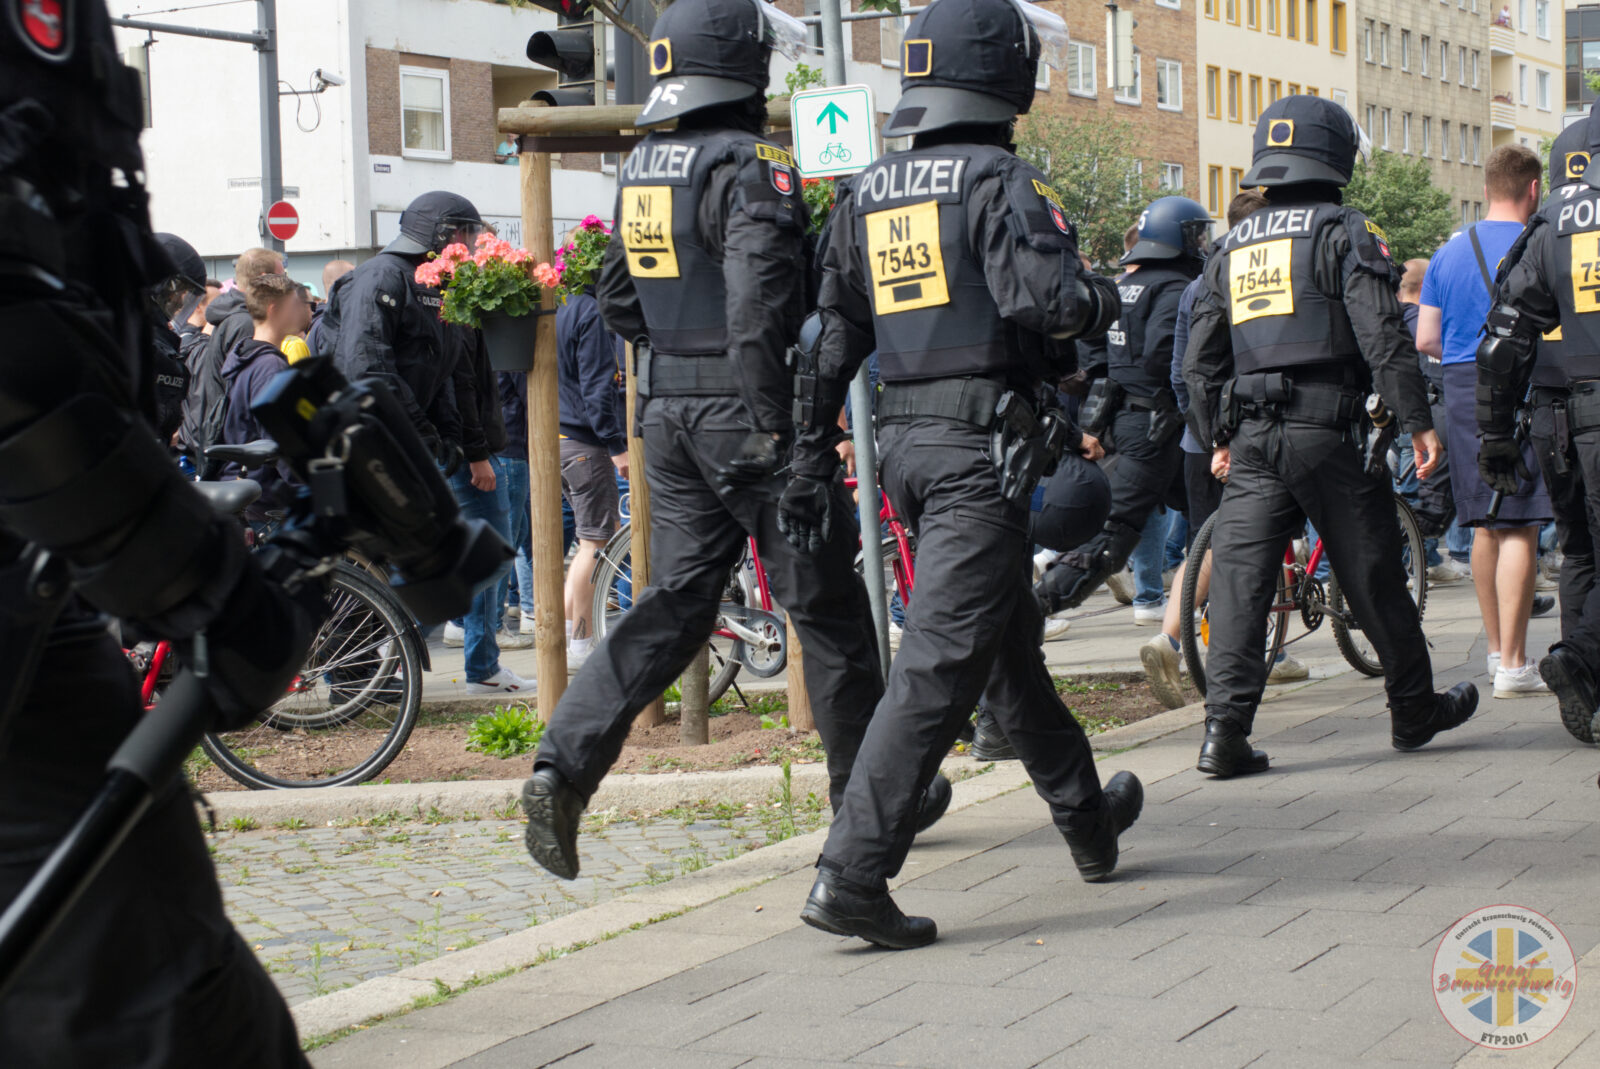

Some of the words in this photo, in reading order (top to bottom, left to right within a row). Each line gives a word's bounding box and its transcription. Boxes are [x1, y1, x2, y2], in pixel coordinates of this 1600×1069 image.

[857, 159, 965, 207] POLIZEI
[637, 194, 652, 218] NI
[627, 221, 664, 245] 7544
[889, 215, 911, 244] NI
[1225, 209, 1314, 249] POLIZEI
[877, 242, 932, 276] 7543
[1249, 248, 1268, 269] NI
[1237, 267, 1283, 294] 7544
